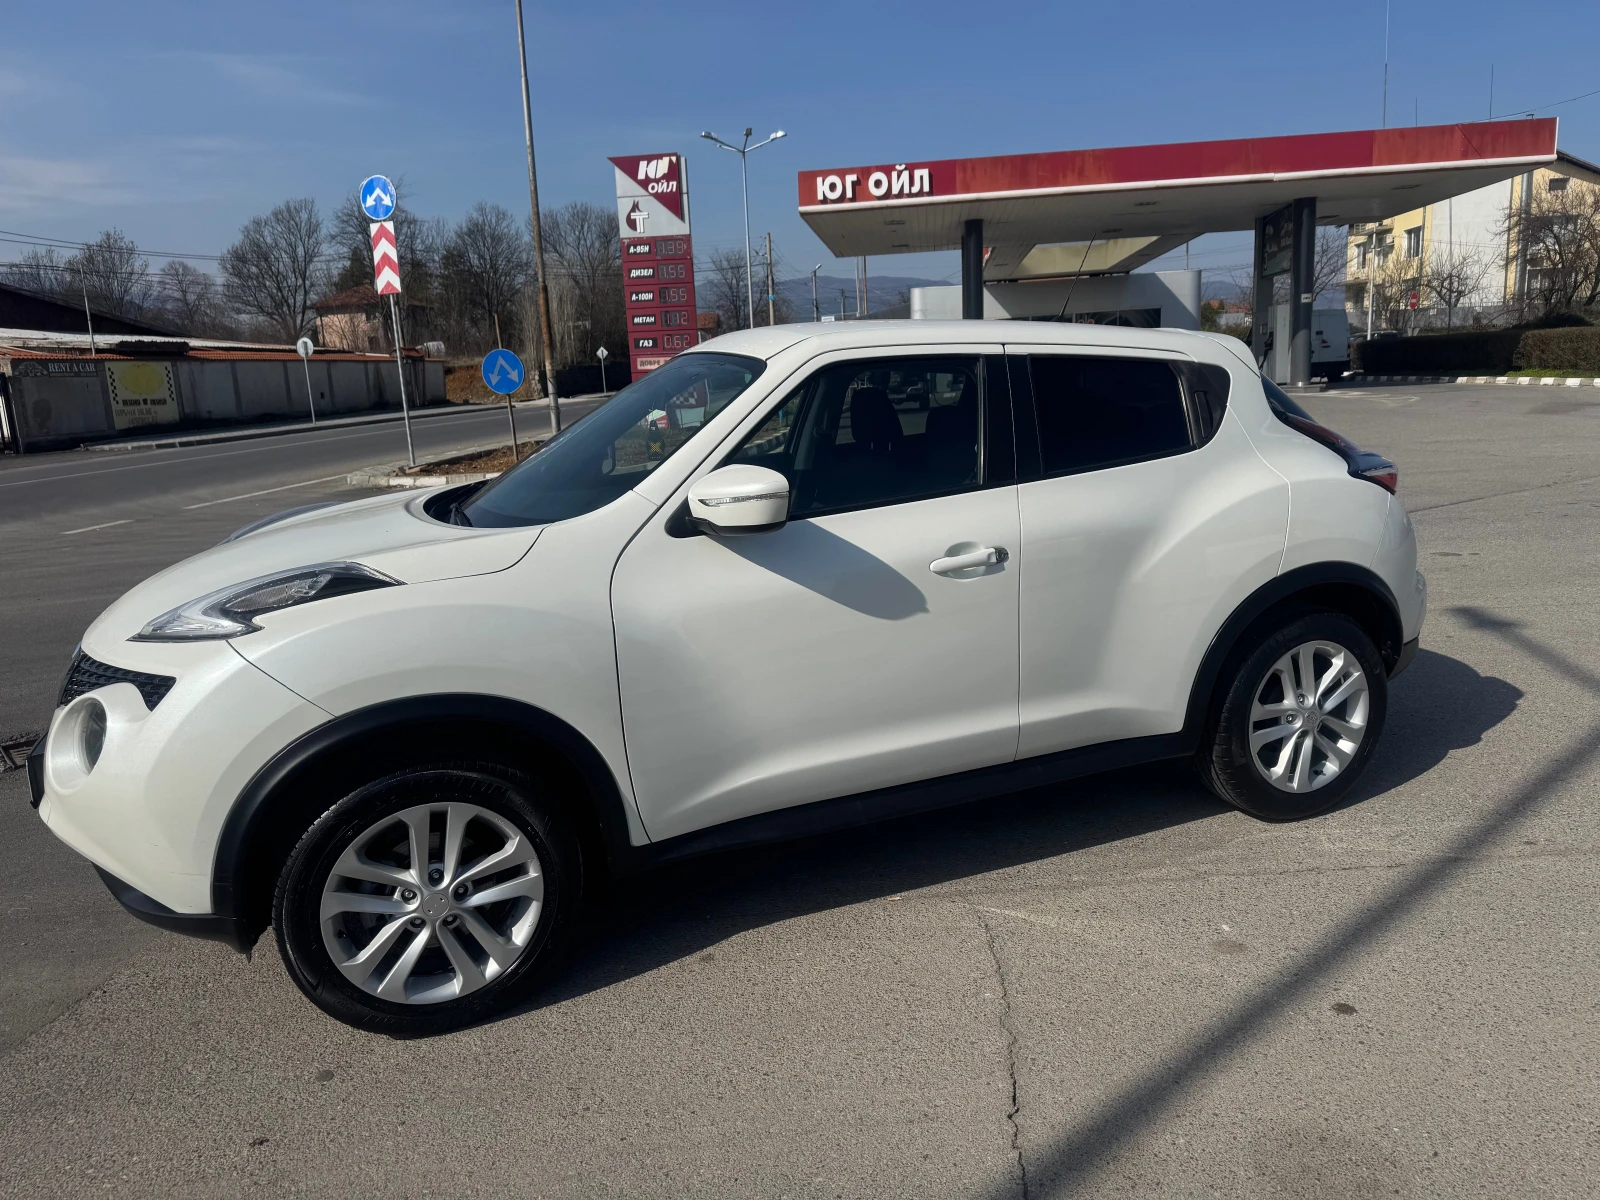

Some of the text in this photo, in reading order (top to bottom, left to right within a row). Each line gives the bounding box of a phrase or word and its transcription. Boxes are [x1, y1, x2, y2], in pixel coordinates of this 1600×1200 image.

[648, 180, 677, 193] ОЙЛ
[816, 163, 930, 201] ЮГ ОЙЛ
[630, 268, 653, 278] ДИЗЕЛ
[48, 362, 96, 373] RENT A CAR
